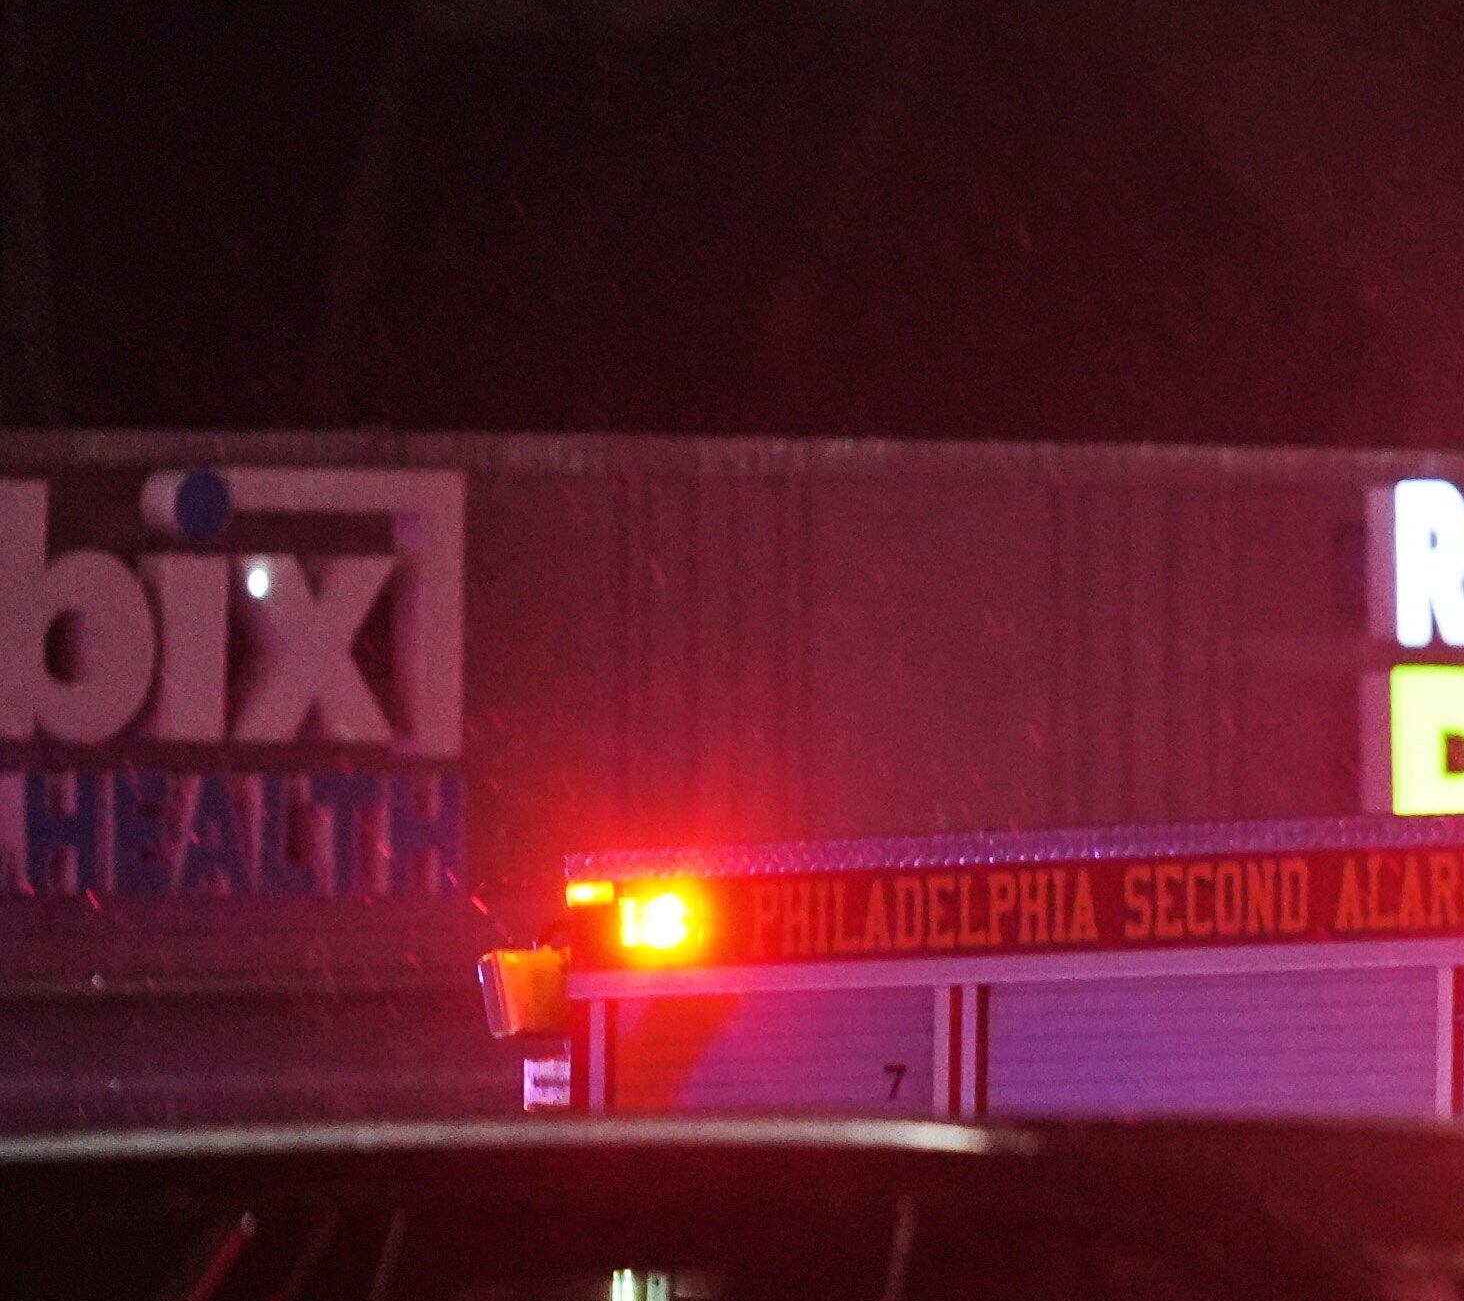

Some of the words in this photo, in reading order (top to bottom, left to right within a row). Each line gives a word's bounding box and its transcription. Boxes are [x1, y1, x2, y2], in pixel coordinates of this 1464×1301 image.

[753, 866, 1098, 958] PHILADELPHIA
[1122, 856, 1309, 939] SECOND
[884, 1064, 907, 1100] 7
